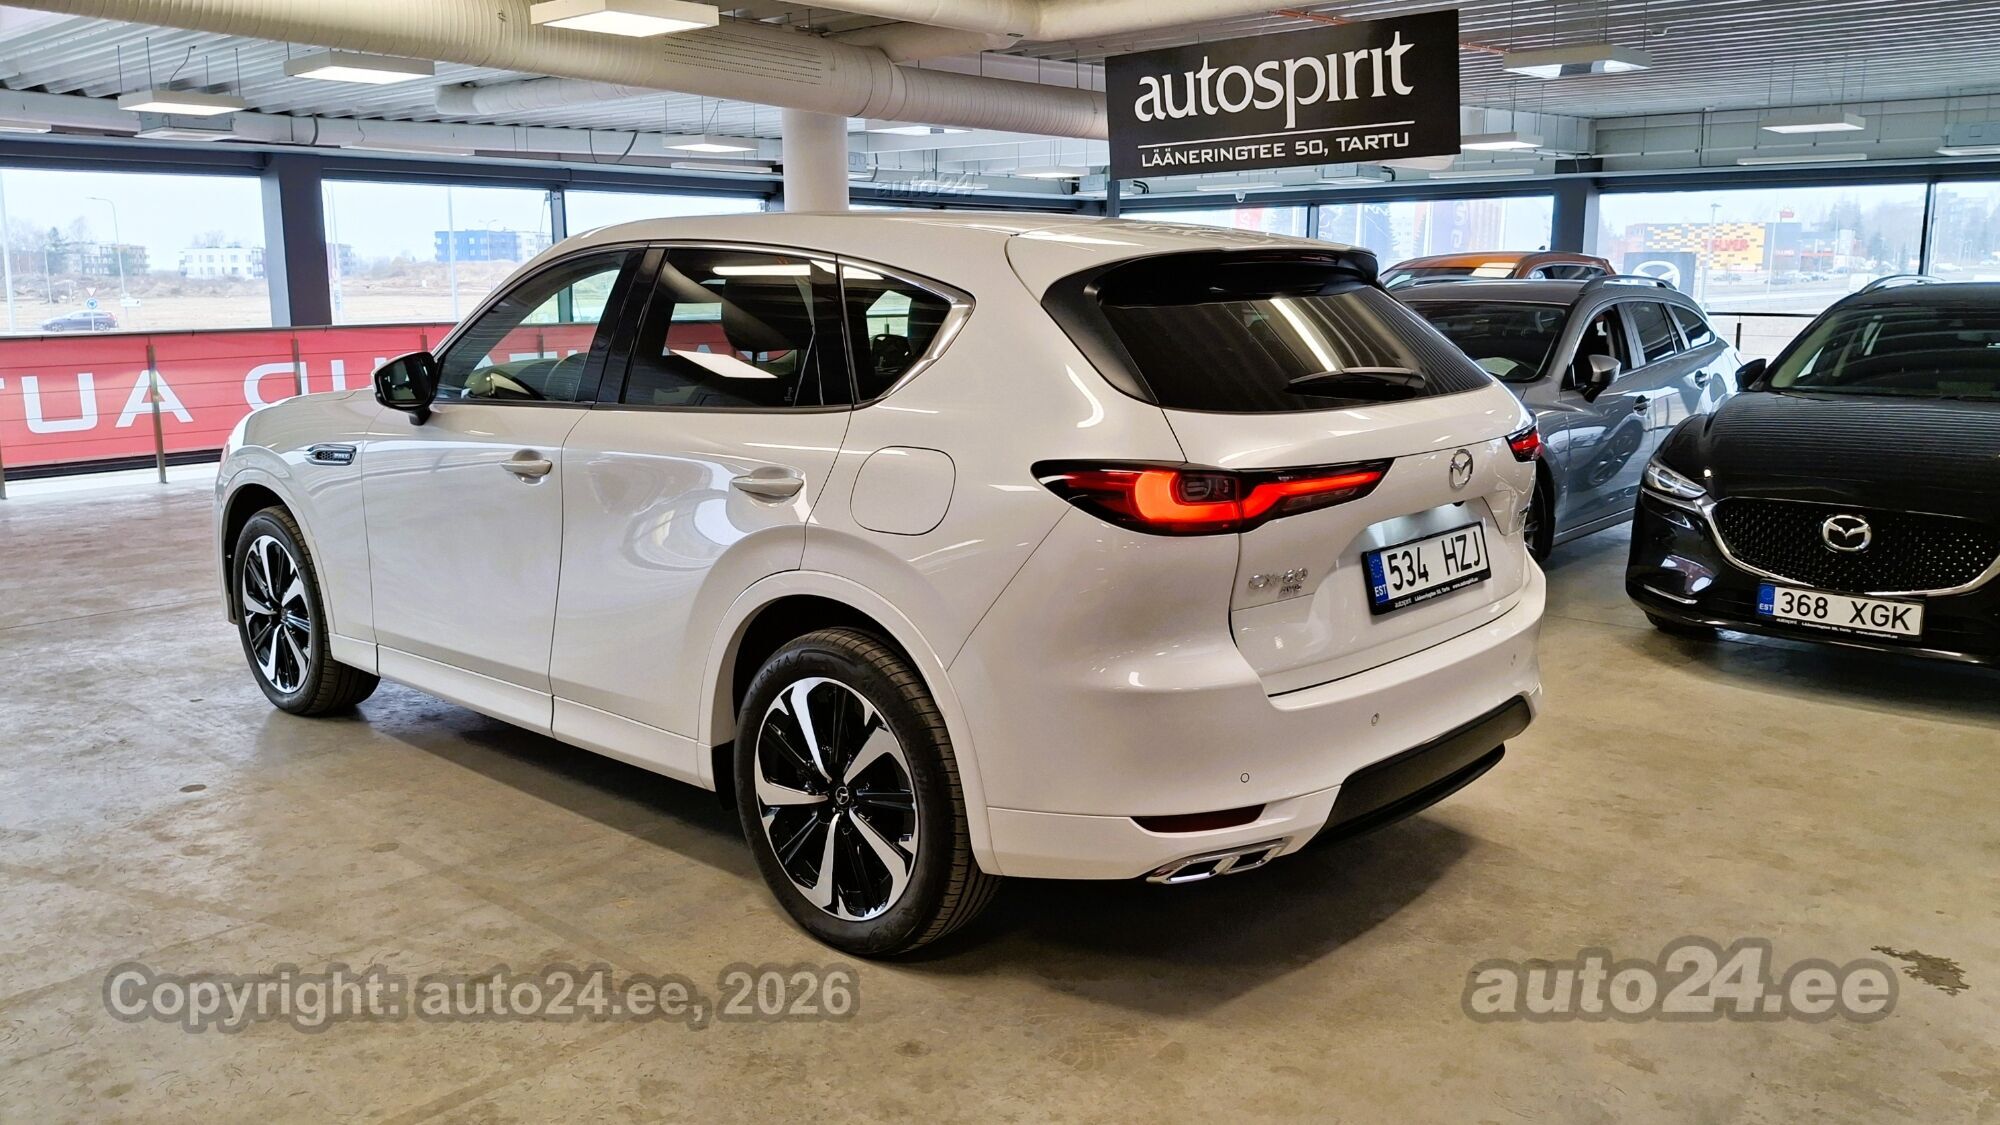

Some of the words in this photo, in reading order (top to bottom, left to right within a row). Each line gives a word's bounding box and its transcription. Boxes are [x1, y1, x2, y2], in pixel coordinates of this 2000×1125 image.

[1134, 31, 1415, 128] autospirit
[1141, 142, 1286, 168] LÄÄNERINGTEE
[1295, 139, 1329, 157] 50,
[1336, 132, 1410, 152] TARTU
[1387, 547, 1429, 591] 534
[1442, 531, 1482, 576] HZJ
[1374, 584, 1388, 597] EST
[1759, 603, 1774, 612] EST
[1780, 591, 1829, 619] 368
[1849, 600, 1913, 631] XGK
